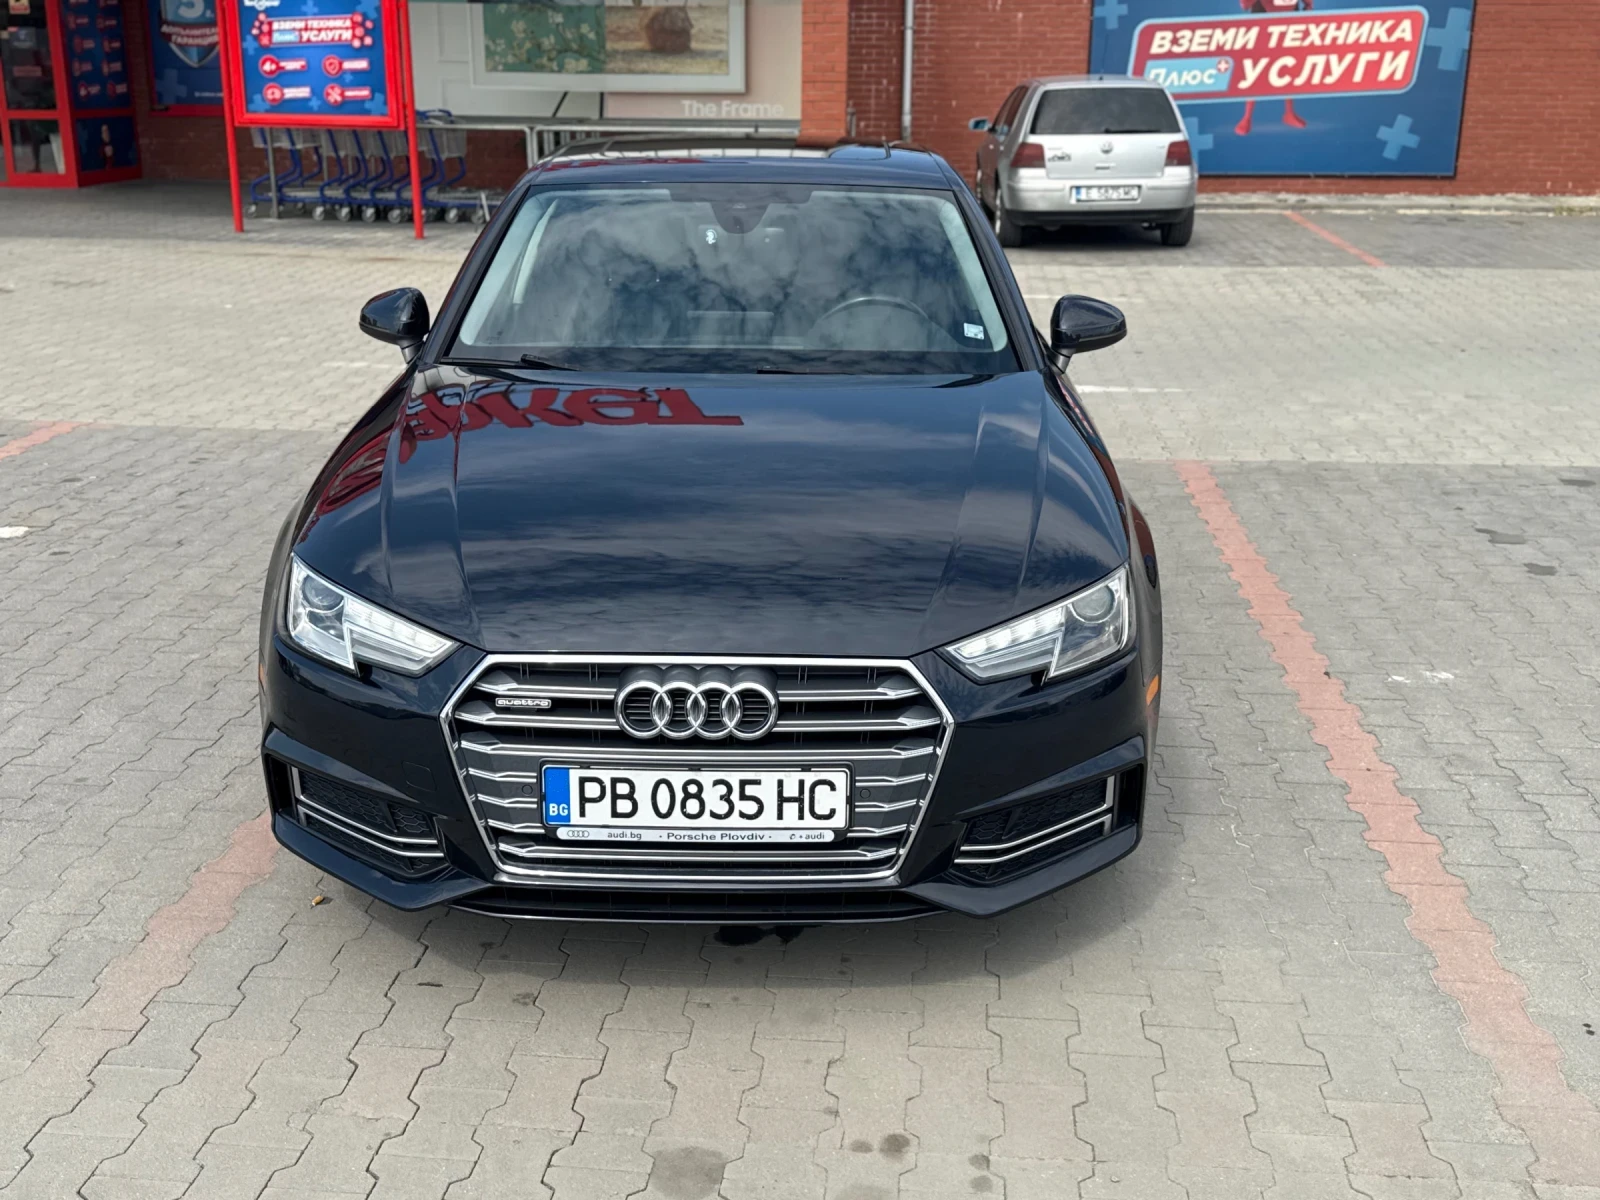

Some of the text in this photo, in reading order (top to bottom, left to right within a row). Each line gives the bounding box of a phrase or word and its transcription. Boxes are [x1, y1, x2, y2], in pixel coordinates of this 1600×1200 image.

[302, 30, 353, 42] УСЛУГИ
[1149, 18, 1414, 55] ВЗЕМИ ТЕХНИКА
[1237, 50, 1411, 90] УСЛУГИ
[681, 99, 784, 118] The Frame
[496, 699, 550, 707] quattro
[578, 776, 838, 821] PB 0835 HC
[549, 803, 569, 817] BG
[607, 830, 642, 841] audi.bg
[667, 832, 716, 841] Porsche
[720, 831, 765, 841] Plovdiv
